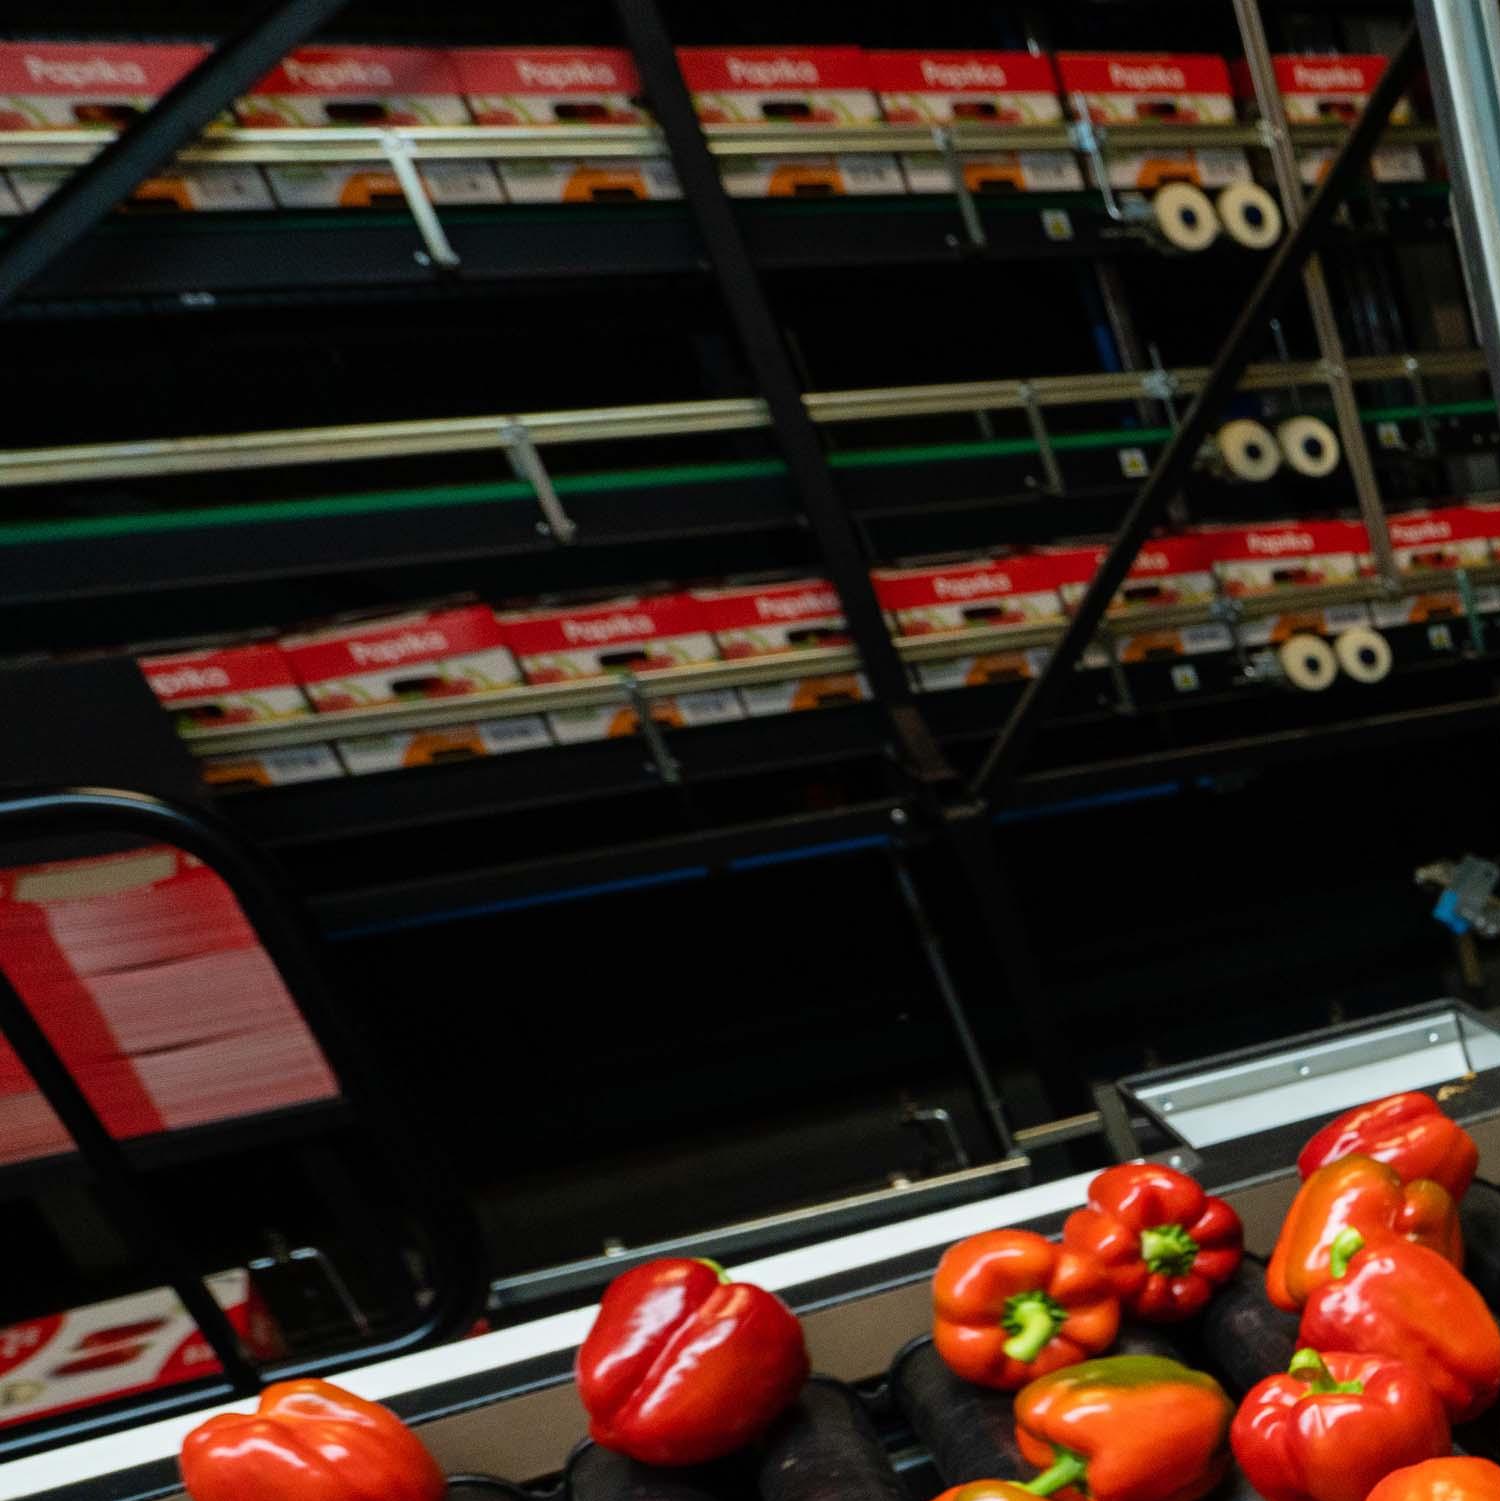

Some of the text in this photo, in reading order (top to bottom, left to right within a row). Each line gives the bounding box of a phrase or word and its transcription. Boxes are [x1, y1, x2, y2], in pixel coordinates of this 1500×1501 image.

[726, 57, 820, 87] Paprika
[920, 59, 1007, 88] Paprika
[1109, 63, 1186, 89] Paprika
[561, 614, 656, 644] Paprika
[348, 630, 449, 666] Paprika
